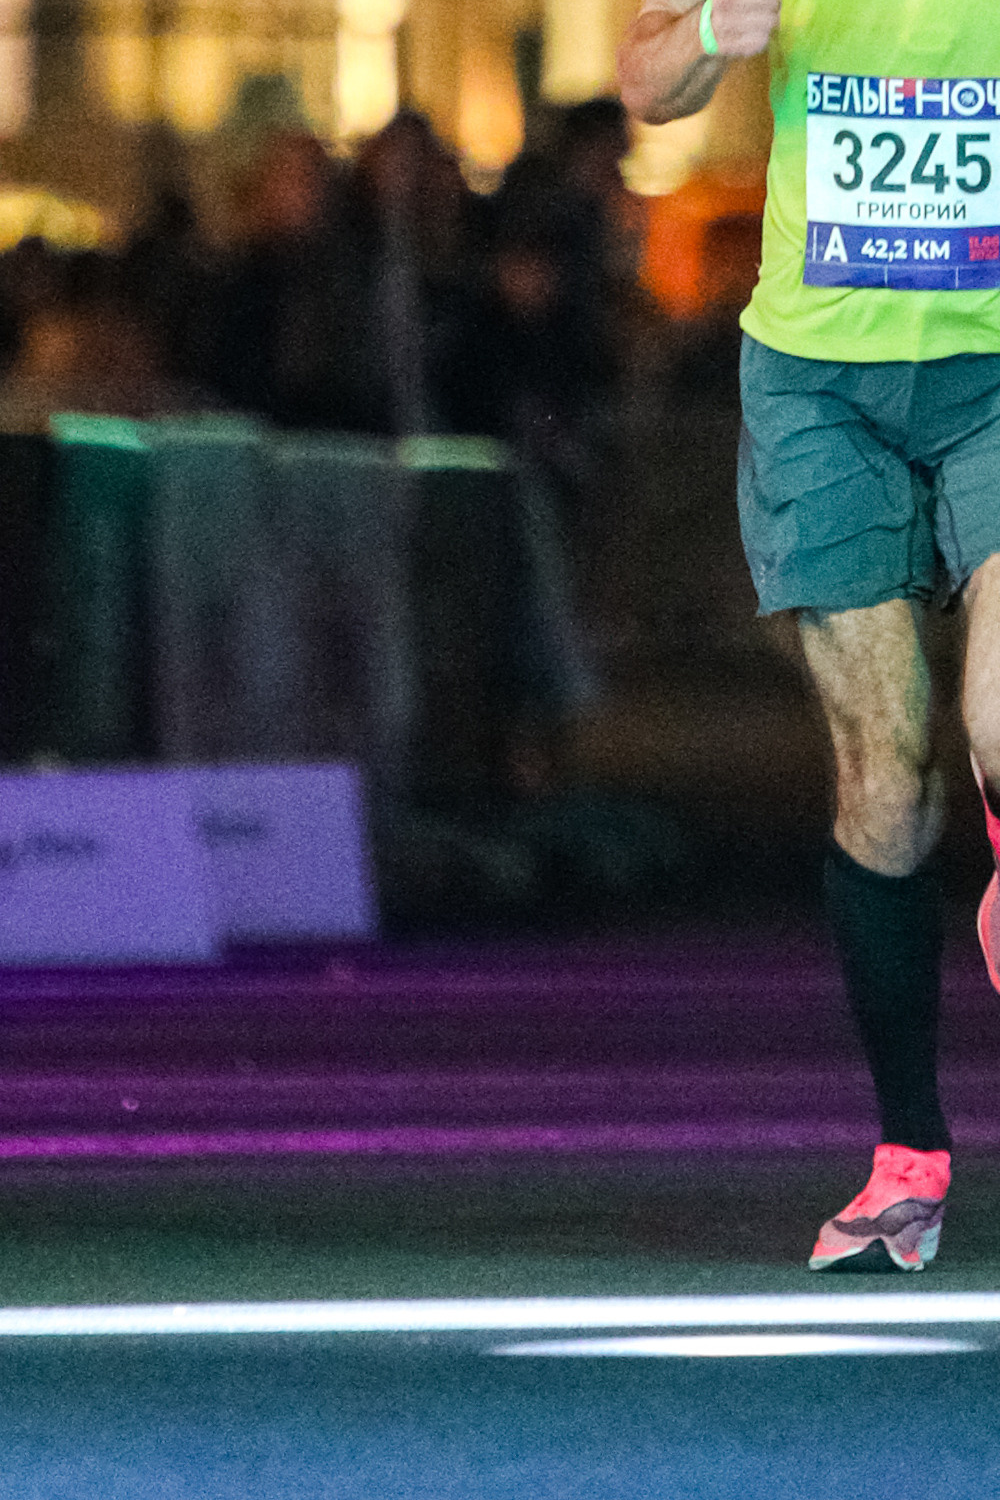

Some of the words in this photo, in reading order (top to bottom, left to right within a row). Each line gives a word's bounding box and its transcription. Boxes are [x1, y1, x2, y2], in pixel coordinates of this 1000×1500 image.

[807, 73, 905, 115] БЕЛЫЕ
[833, 130, 992, 194] 3245
[857, 199, 967, 220] ГРИГОРИЙ
[861, 238, 907, 262] 42,2
[914, 240, 950, 260] КМ
